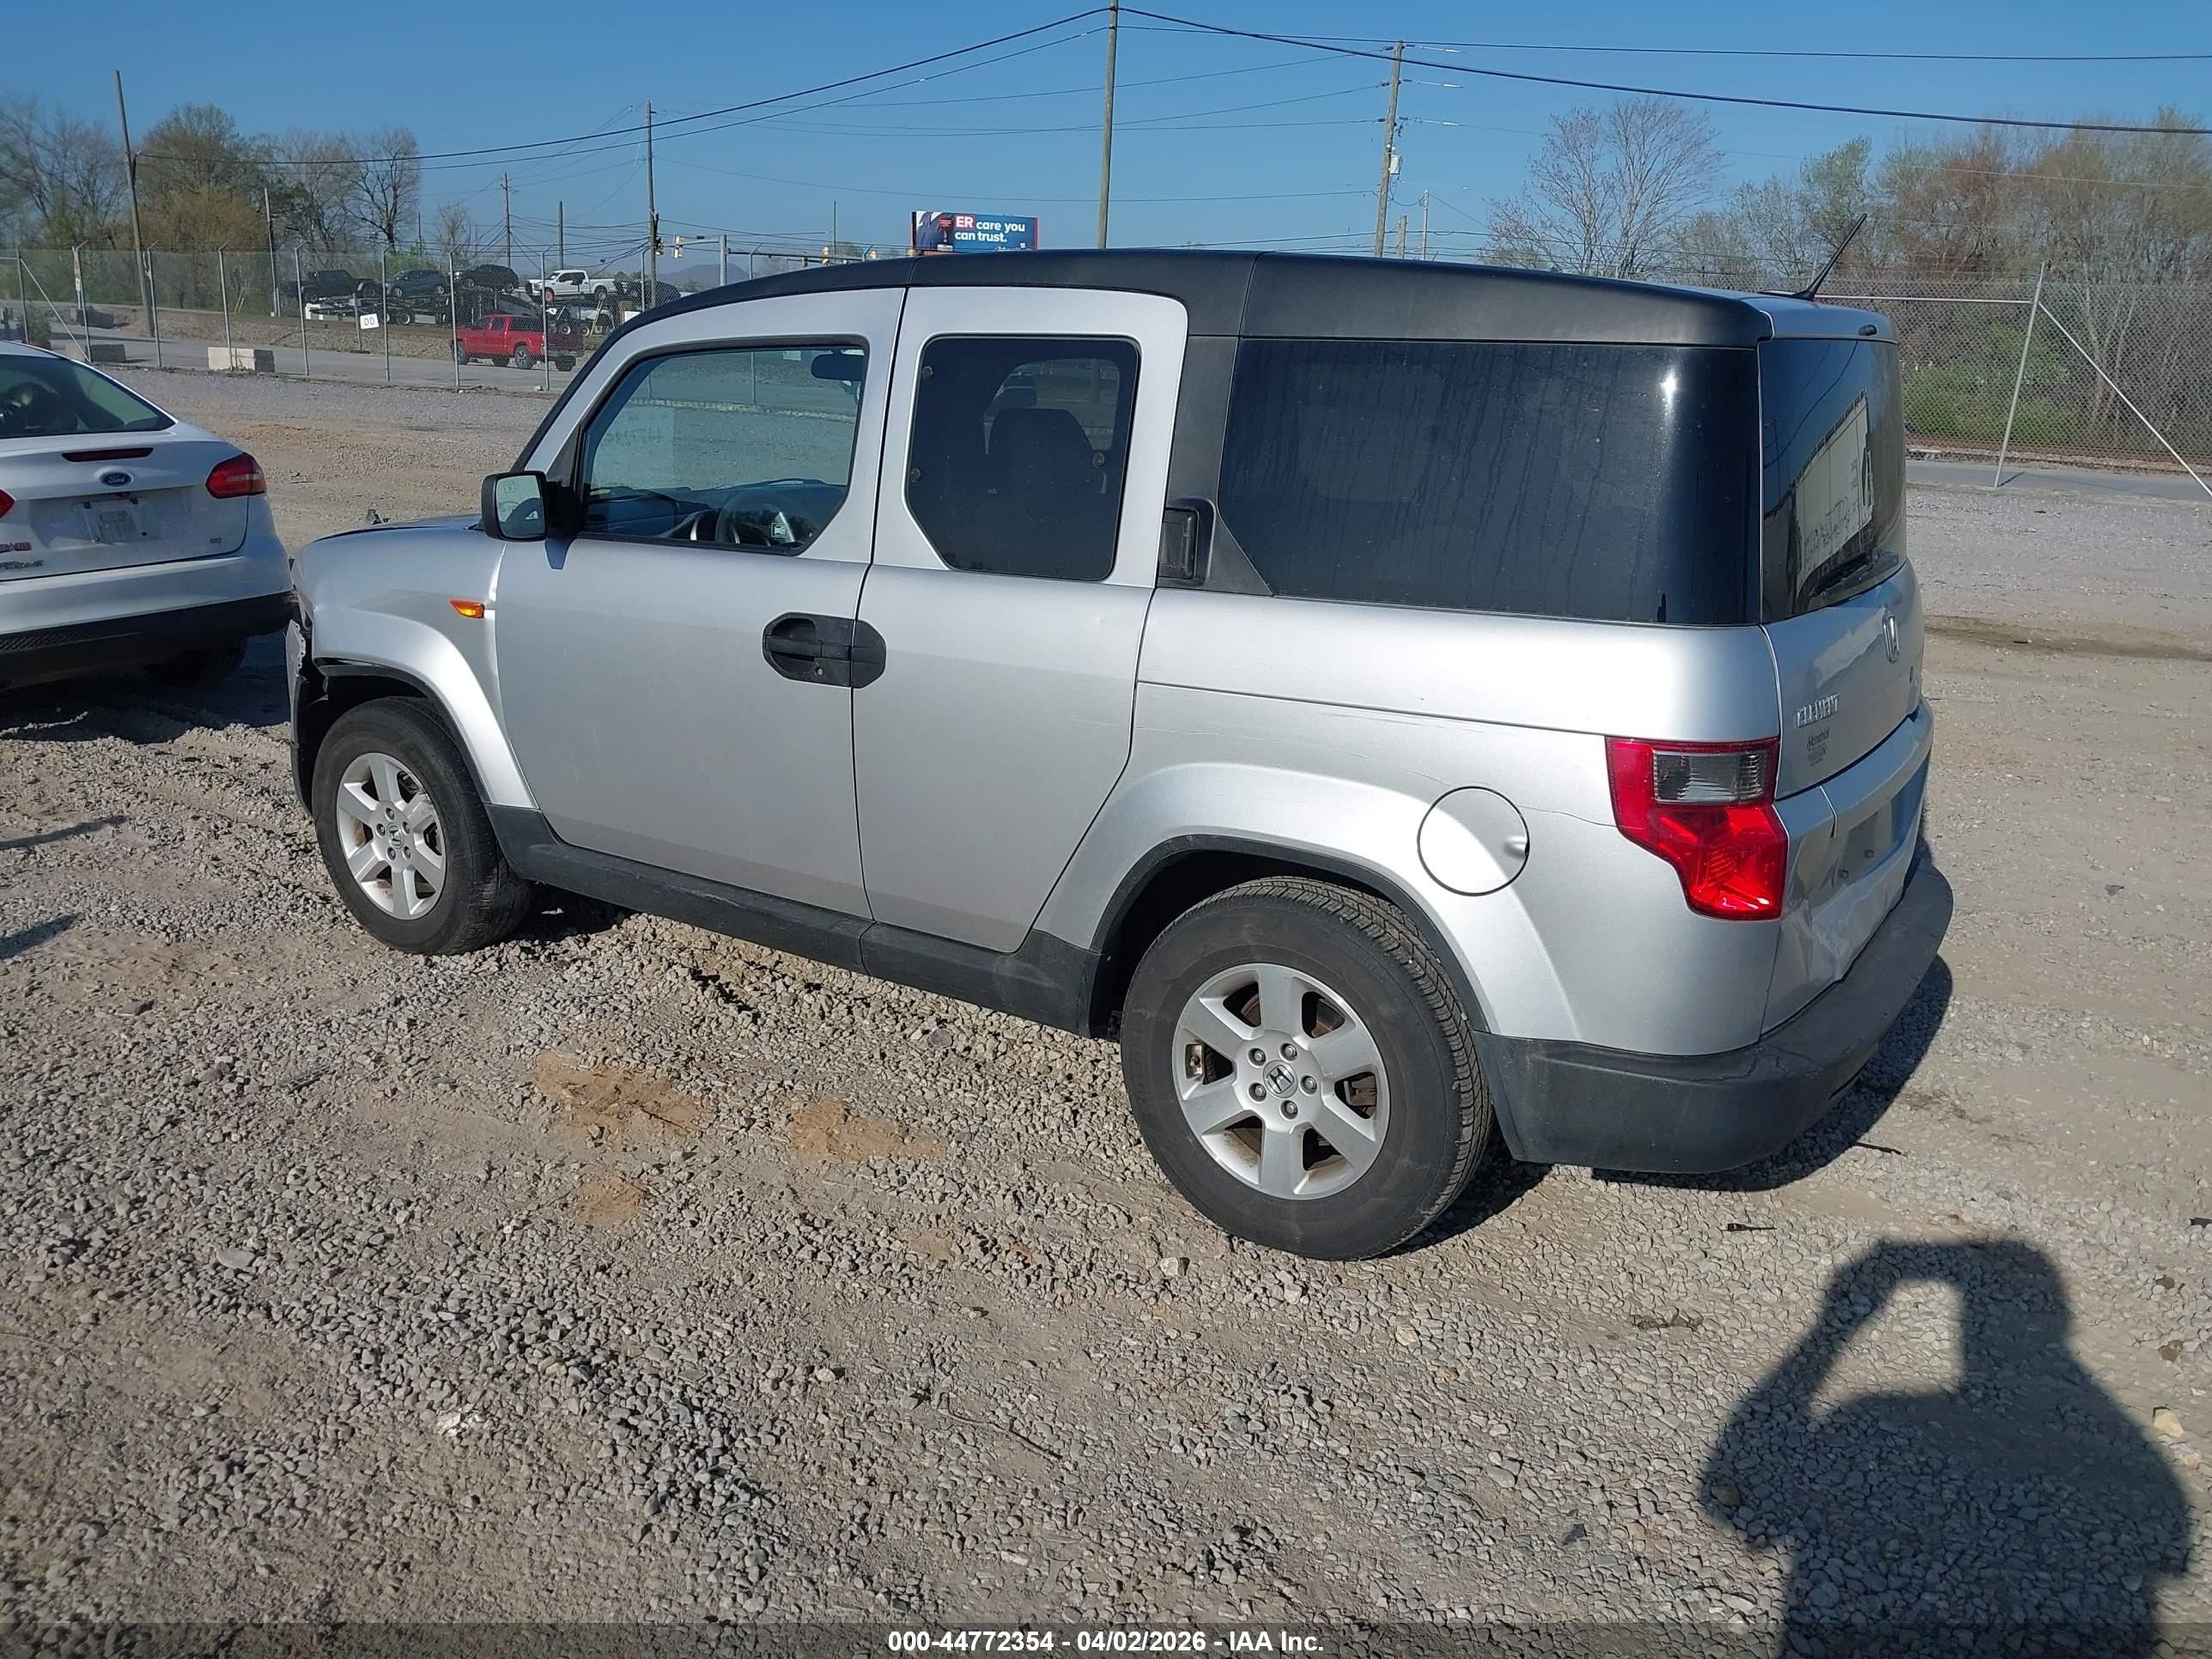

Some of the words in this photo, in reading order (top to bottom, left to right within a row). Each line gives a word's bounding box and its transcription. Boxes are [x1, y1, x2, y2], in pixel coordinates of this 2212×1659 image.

[956, 216, 974, 228] ER
[976, 222, 1001, 230] care
[1004, 223, 1025, 233] you
[955, 232, 975, 240] can
[977, 232, 1007, 242] trust.
